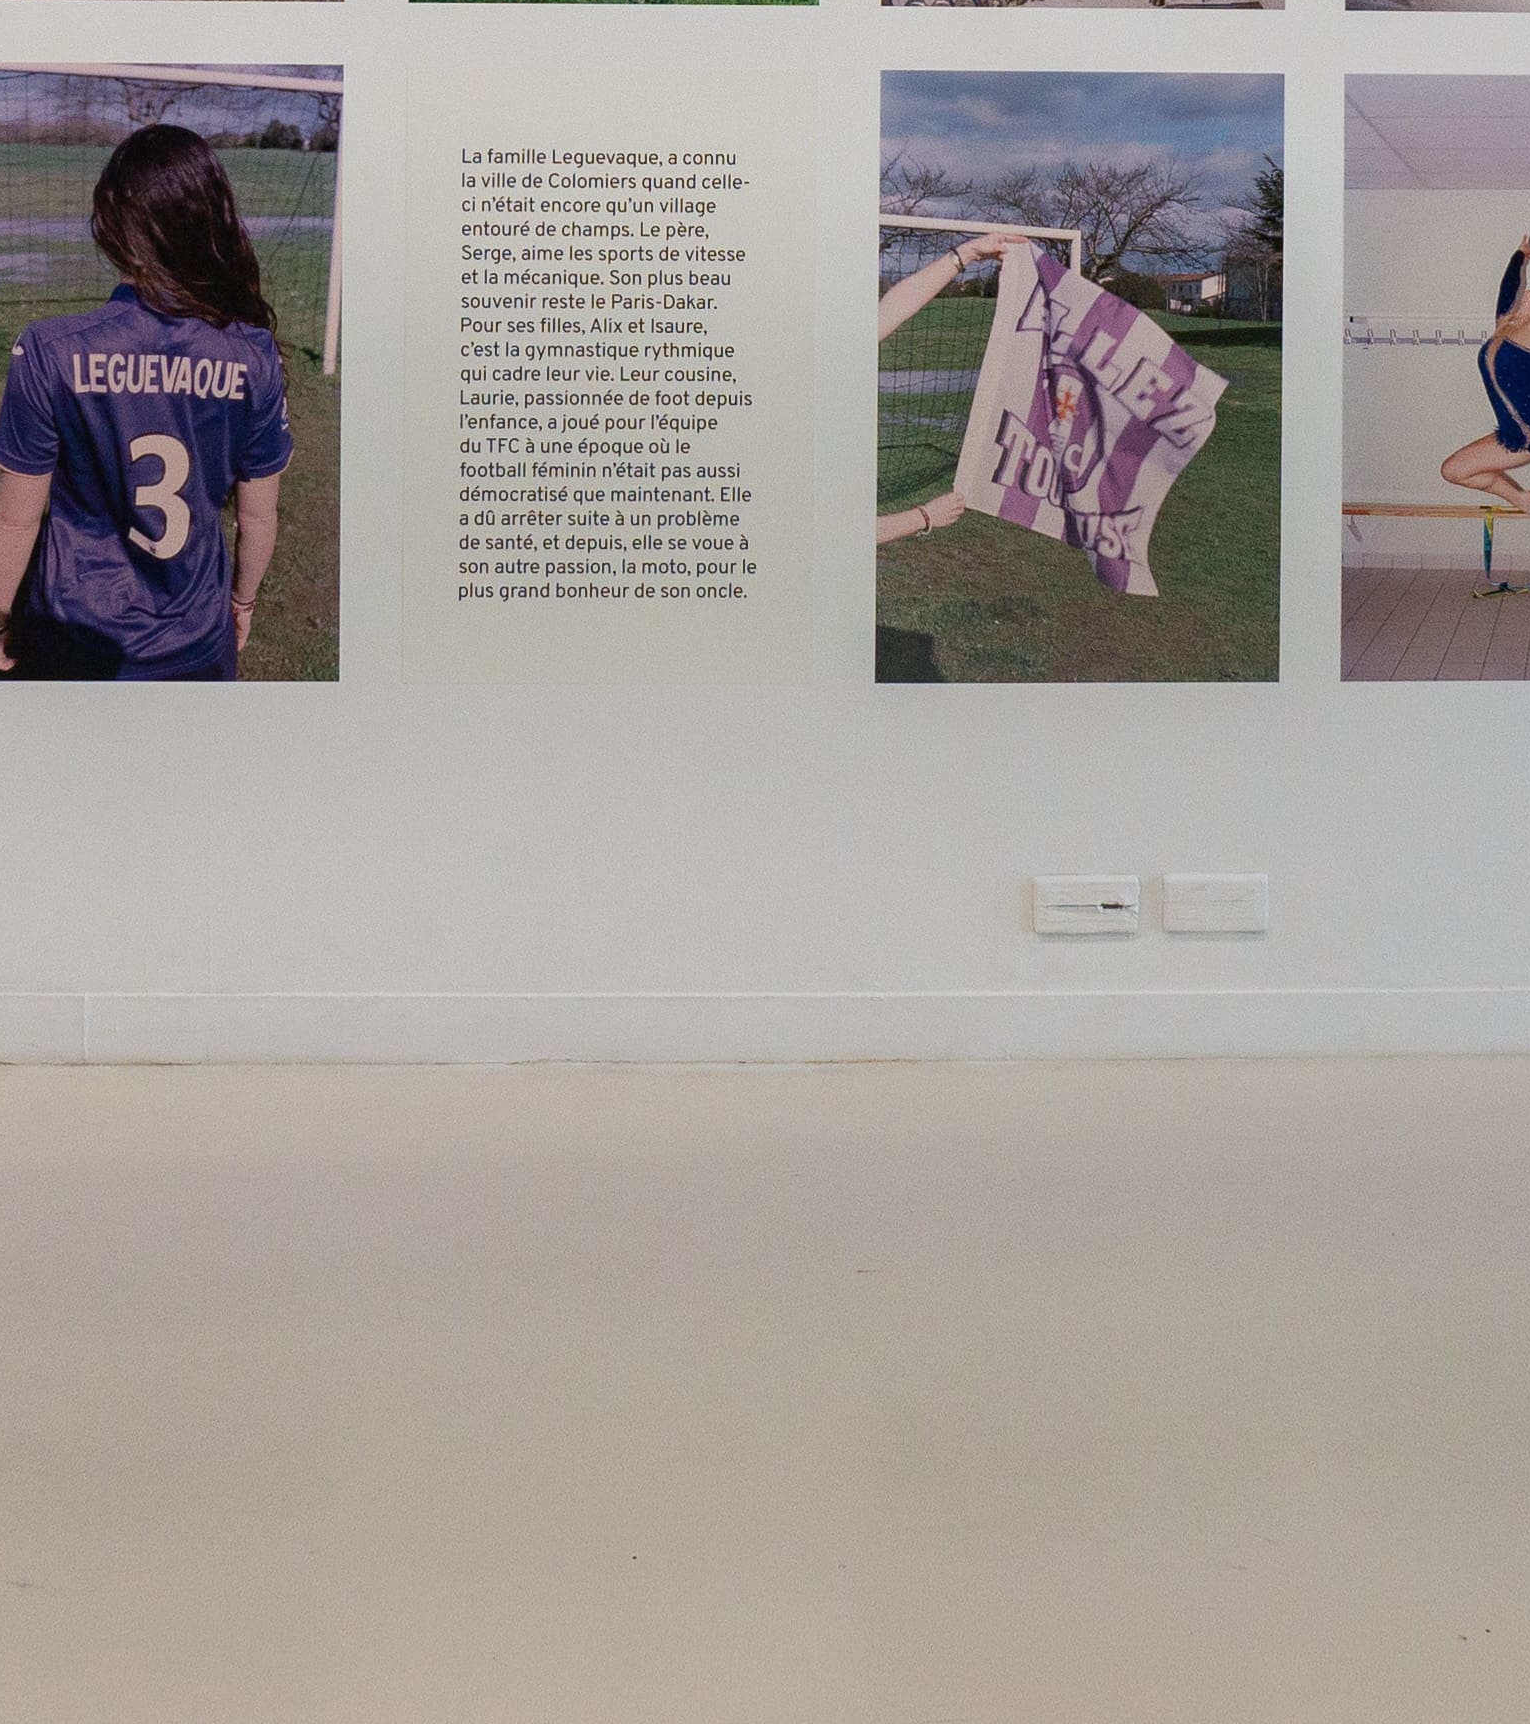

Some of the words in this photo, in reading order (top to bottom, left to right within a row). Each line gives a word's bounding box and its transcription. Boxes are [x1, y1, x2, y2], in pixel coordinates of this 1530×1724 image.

[461, 149, 483, 165] La
[486, 149, 547, 165] famille
[551, 149, 664, 169] Leguevaque,
[667, 152, 678, 165] a
[682, 152, 737, 165] connu
[461, 173, 477, 189] la
[480, 173, 517, 189] ville
[521, 173, 544, 189] de
[547, 173, 637, 189] Colomiers
[641, 173, 697, 193] quand
[701, 173, 750, 189] celle-
[461, 197, 476, 213] ci
[481, 196, 536, 213] n'était
[539, 201, 602, 213] encore
[605, 197, 654, 217] qu'un
[659, 197, 717, 217] village
[461, 220, 531, 237] entouré
[534, 221, 557, 237] de
[561, 221, 635, 241] champs.
[639, 221, 661, 237] Le
[665, 220, 710, 241] père,
[461, 245, 517, 265] Serge,
[520, 245, 565, 261] aime
[569, 245, 594, 261] les
[597, 245, 654, 265] sports
[658, 245, 681, 261] de
[684, 245, 746, 261] vitesse
[460, 270, 479, 286] et
[483, 270, 499, 286] la
[503, 268, 605, 290] mécanique.
[609, 270, 642, 286] Son
[647, 270, 684, 290] plus
[688, 270, 731, 286] beau
[460, 294, 538, 310] souvenir
[541, 294, 586, 310] reste
[590, 294, 606, 310] le
[611, 294, 718, 310] Paris-Dakar.
[460, 318, 503, 334] Pour
[506, 321, 536, 334] ses
[539, 318, 586, 336] filles,
[589, 318, 623, 334] Alix
[627, 318, 646, 334] et
[650, 318, 708, 336] Isaure,
[460, 342, 501, 358] c'est
[505, 342, 520, 358] la
[524, 342, 640, 362] gymnastique
[644, 342, 735, 362] rythmique
[72, 353, 249, 401] LEGUEVAQUE
[460, 366, 487, 386] qui
[491, 366, 542, 382] cadre
[546, 366, 581, 382] leur
[584, 366, 615, 382] vie.
[619, 366, 661, 382] Leur
[664, 366, 737, 384] cousine,
[459, 390, 520, 408] Laurie,
[524, 389, 624, 410] passionnée
[628, 390, 651, 406] de
[654, 390, 690, 406] foot
[694, 390, 753, 410] depuis
[459, 414, 543, 432] l'enfance,
[547, 418, 558, 430] a
[560, 413, 600, 434] joué
[604, 418, 647, 434] pour
[650, 413, 719, 434] l'équipe
[459, 438, 482, 454] du
[485, 438, 520, 454] TFC
[525, 437, 535, 454] à
[540, 442, 574, 454] une
[577, 437, 644, 458] époque
[648, 437, 670, 454] où
[675, 438, 691, 454] le
[459, 462, 527, 478] football
[531, 461, 597, 478] féminin
[602, 461, 656, 478] n'était
[661, 466, 692, 482] pas
[696, 462, 741, 478] aussi
[127, 432, 194, 560] 3
[459, 485, 569, 502] démocratisé
[572, 490, 606, 506] que
[610, 486, 715, 502] maintenant.
[720, 486, 752, 502] Elle
[991, 408, 1144, 566] TOUUSE
[458, 514, 469, 526] a
[473, 510, 496, 526] dû
[500, 510, 564, 526] arrêter
[567, 510, 611, 526] suite
[614, 510, 625, 526] à
[629, 514, 652, 526] un
[656, 510, 741, 530] problème
[458, 535, 481, 551] de
[485, 534, 538, 553] santé,
[542, 535, 560, 551] et
[564, 535, 628, 555] depuis,
[631, 535, 664, 551] elle
[667, 538, 688, 551] se
[691, 538, 735, 551] voue
[738, 534, 749, 551] à
[458, 562, 490, 575] son
[494, 559, 541, 575] autre
[545, 559, 617, 579] passion,
[621, 559, 637, 575] la
[641, 559, 692, 577] moto,
[696, 562, 738, 579] pour
[742, 559, 758, 575] le
[458, 583, 495, 603] plus
[498, 583, 551, 603] grand
[555, 583, 630, 599] bonheur
[633, 583, 656, 599] de
[660, 586, 691, 599] son
[695, 583, 748, 599] oncle.
